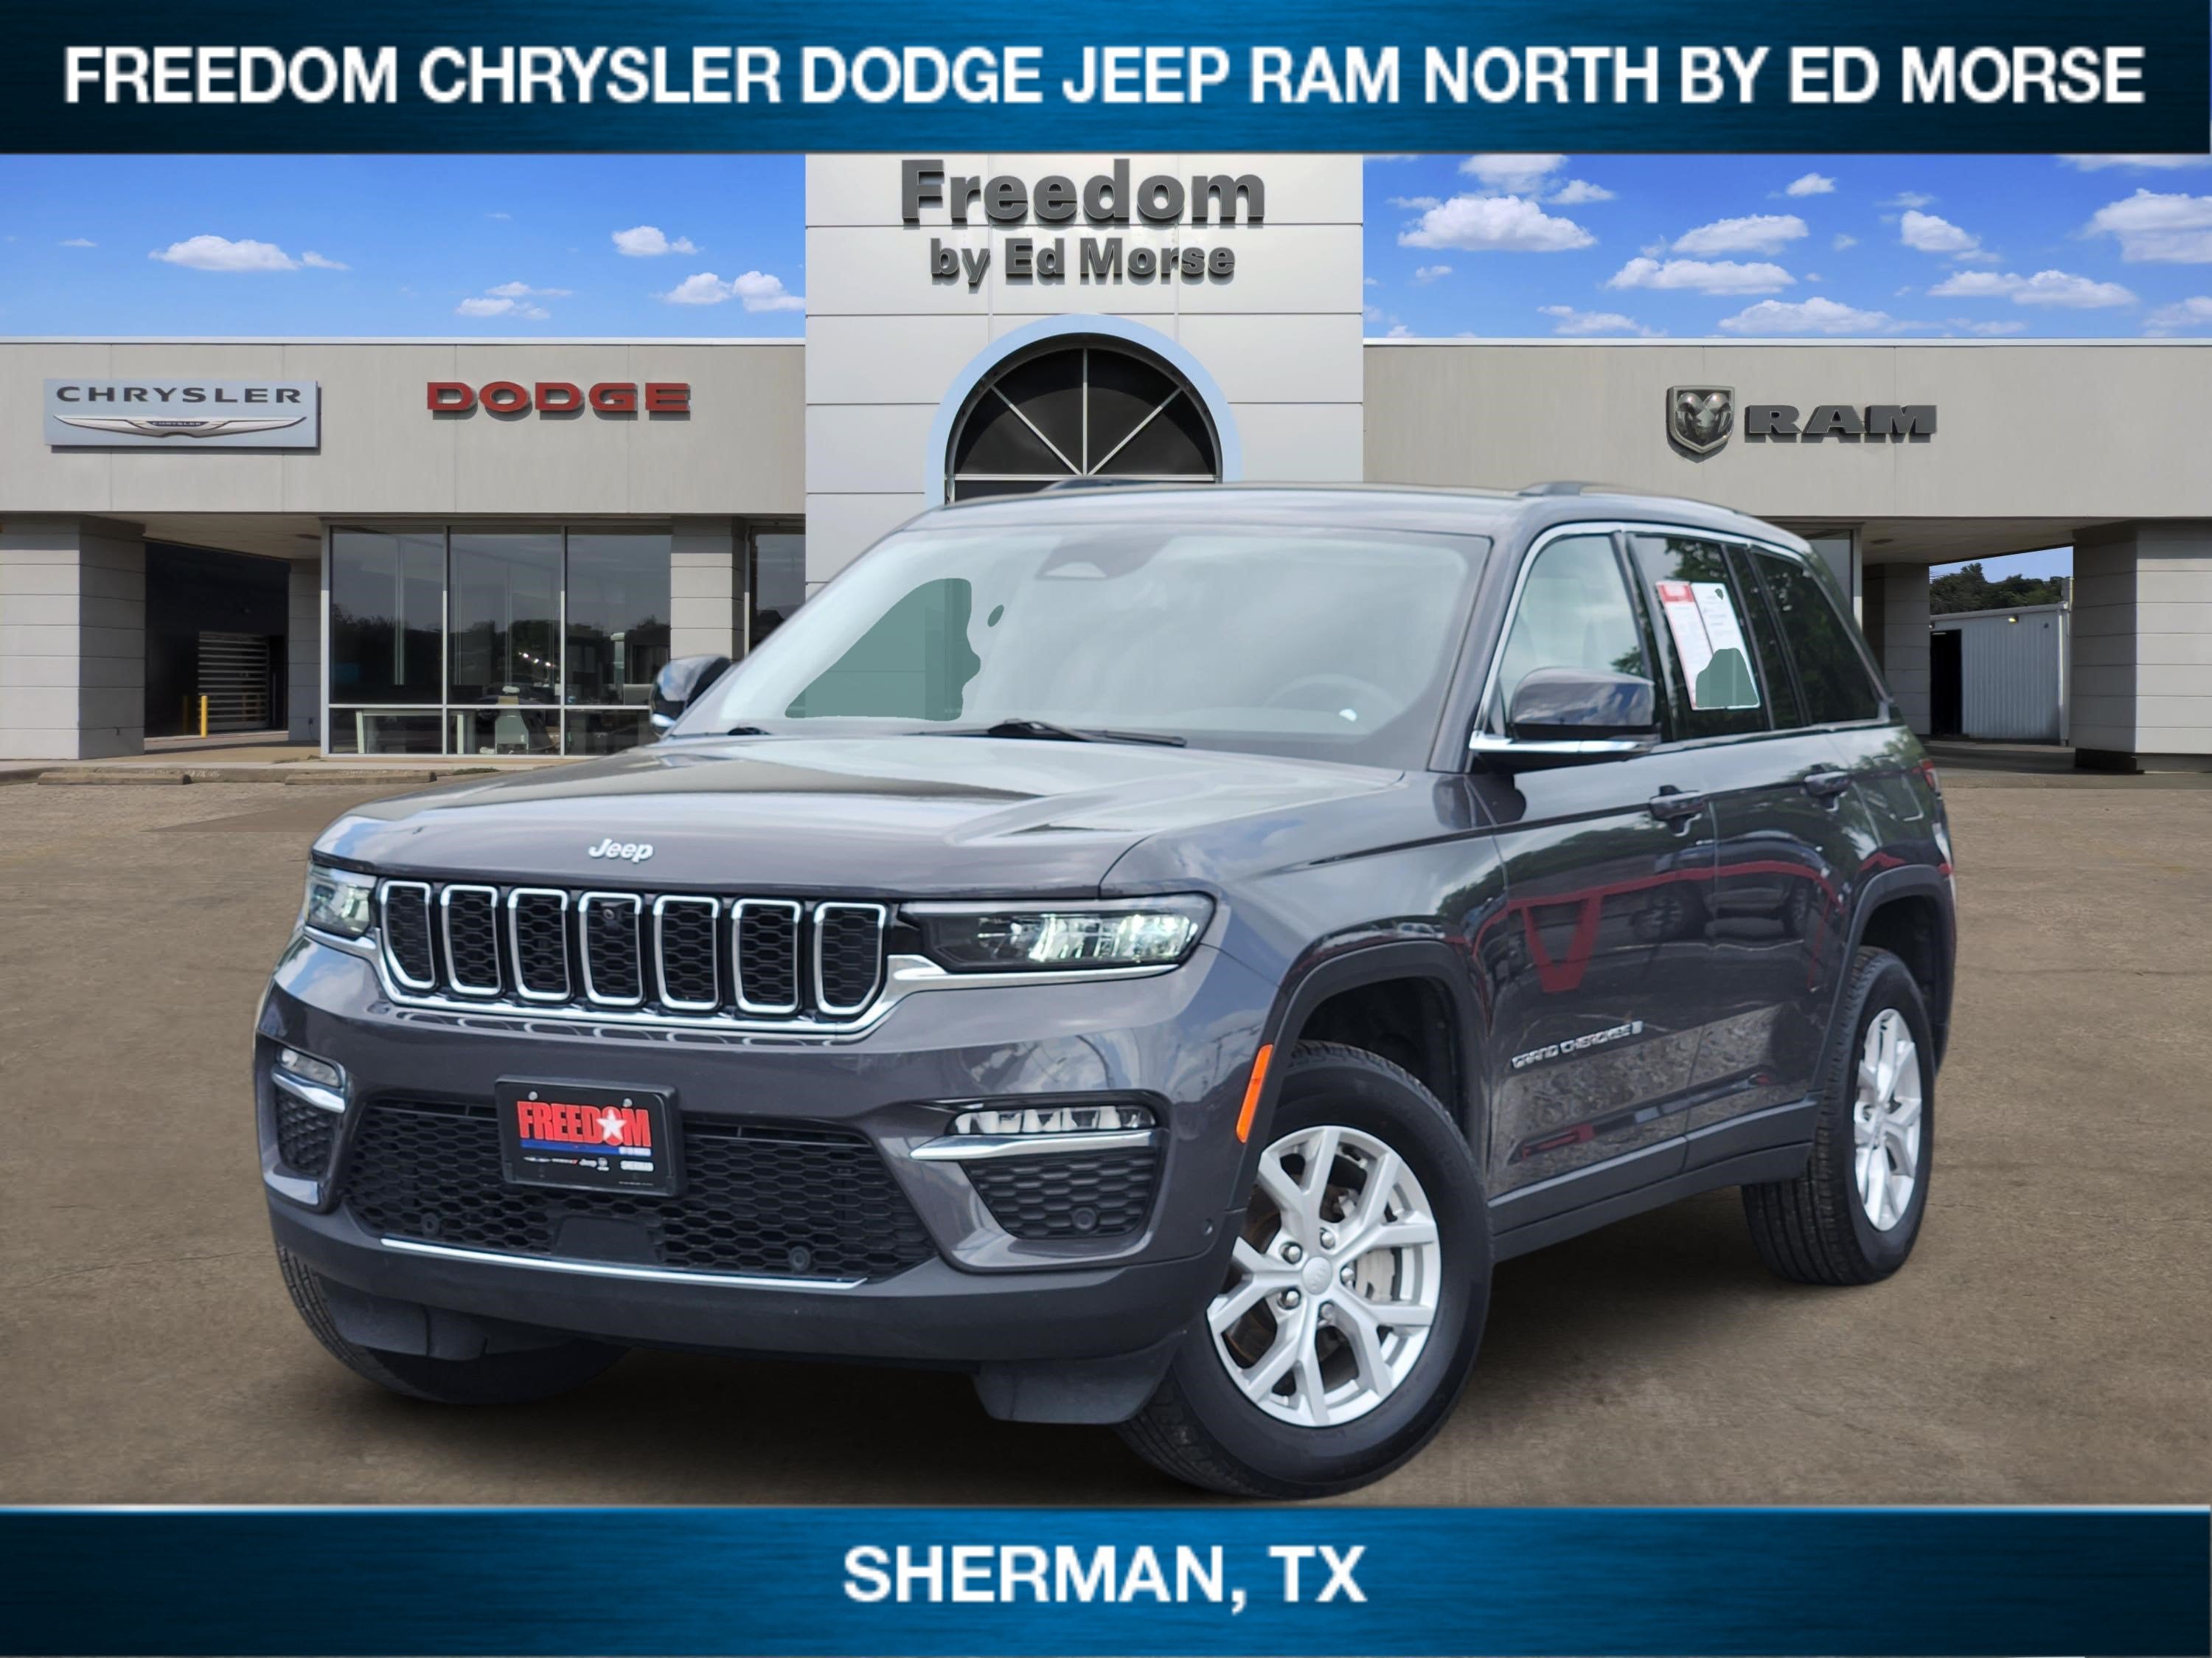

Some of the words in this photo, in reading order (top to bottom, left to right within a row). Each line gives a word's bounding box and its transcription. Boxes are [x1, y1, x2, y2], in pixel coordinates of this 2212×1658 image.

[902, 159, 1265, 222] Freedom
[930, 237, 990, 285] by
[1005, 237, 1065, 277] Ed
[1080, 237, 1235, 277] Morse
[56, 386, 302, 403] CHRYSLER
[427, 381, 690, 412] DODGE
[1745, 405, 1938, 435] RAM
[588, 838, 654, 864] Jeep
[517, 1100, 652, 1147] FREEDOM
